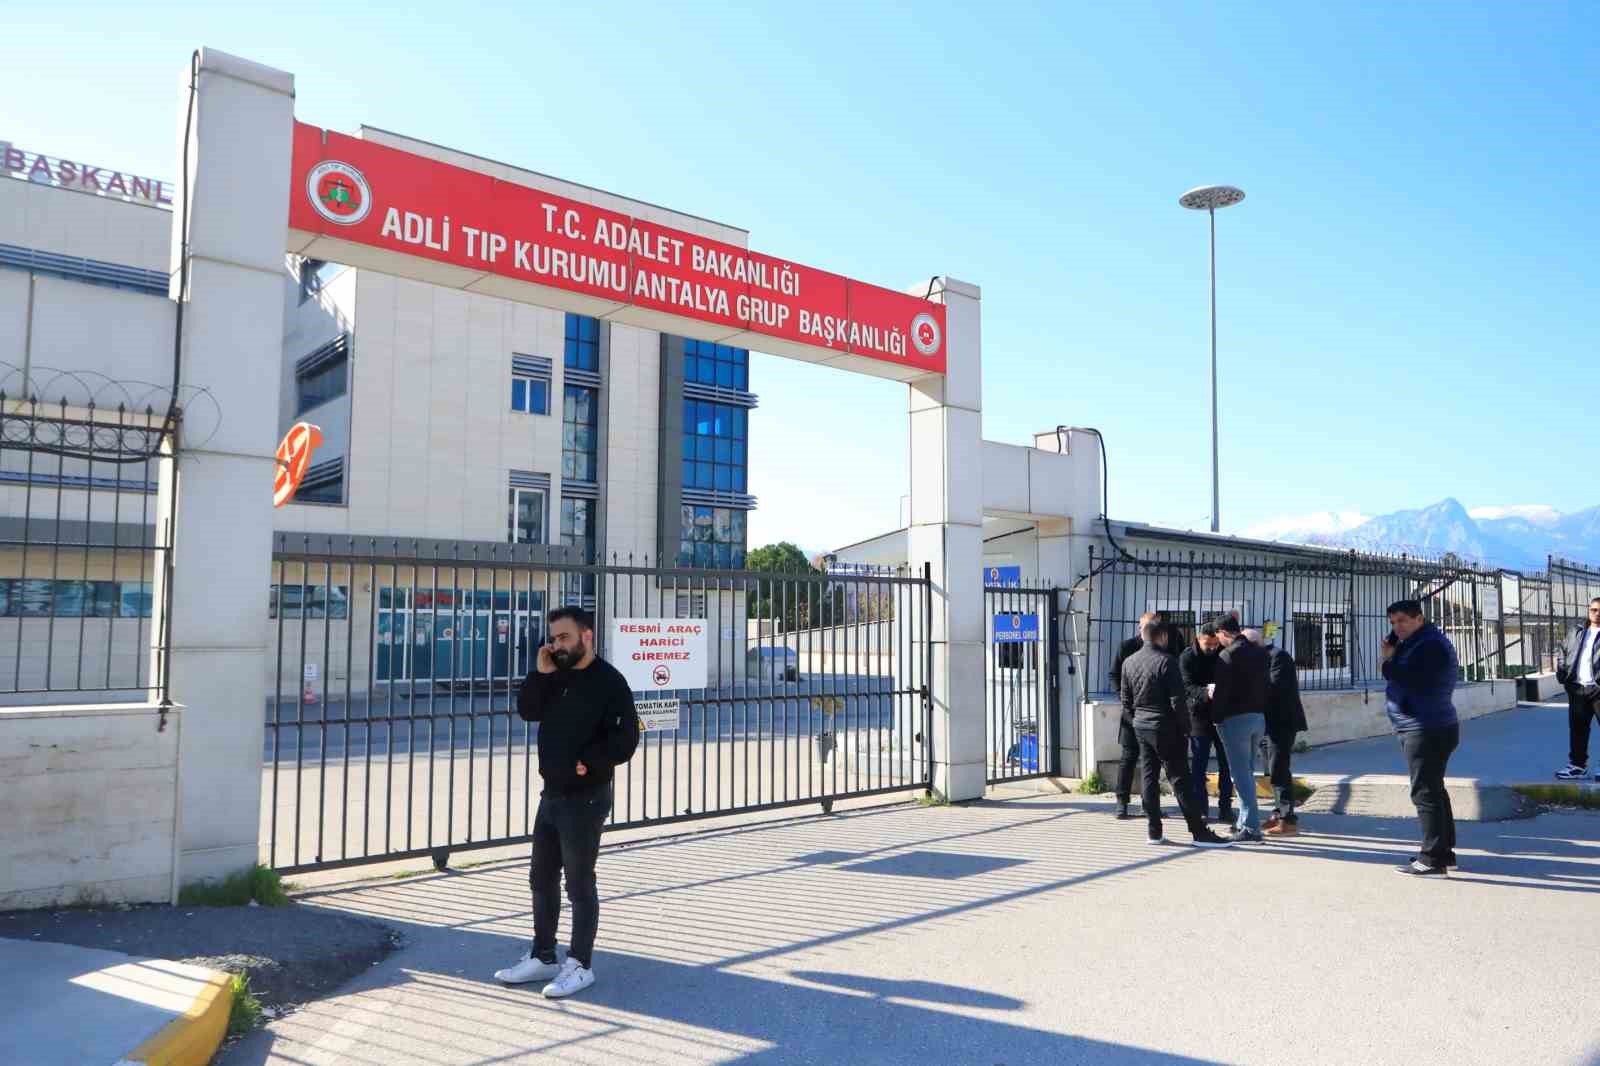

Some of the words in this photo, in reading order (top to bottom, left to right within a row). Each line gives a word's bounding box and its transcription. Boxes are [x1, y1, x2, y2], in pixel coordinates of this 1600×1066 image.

[541, 203, 586, 240] T.C.
[593, 218, 685, 266] ADALET
[692, 244, 800, 297] BAKANLIĞI
[381, 206, 451, 251] ADLİ
[461, 225, 507, 263] TIP
[514, 239, 628, 293] KURUMU
[634, 269, 731, 317] ANTALYA
[736, 294, 790, 329] GRUP
[799, 308, 907, 357] BAŞKANLIĞI
[620, 623, 661, 633] RESMİ
[667, 625, 701, 635] ARAÇ
[640, 637, 684, 646] HARİCİ
[631, 652, 690, 660] GİREMEZ
